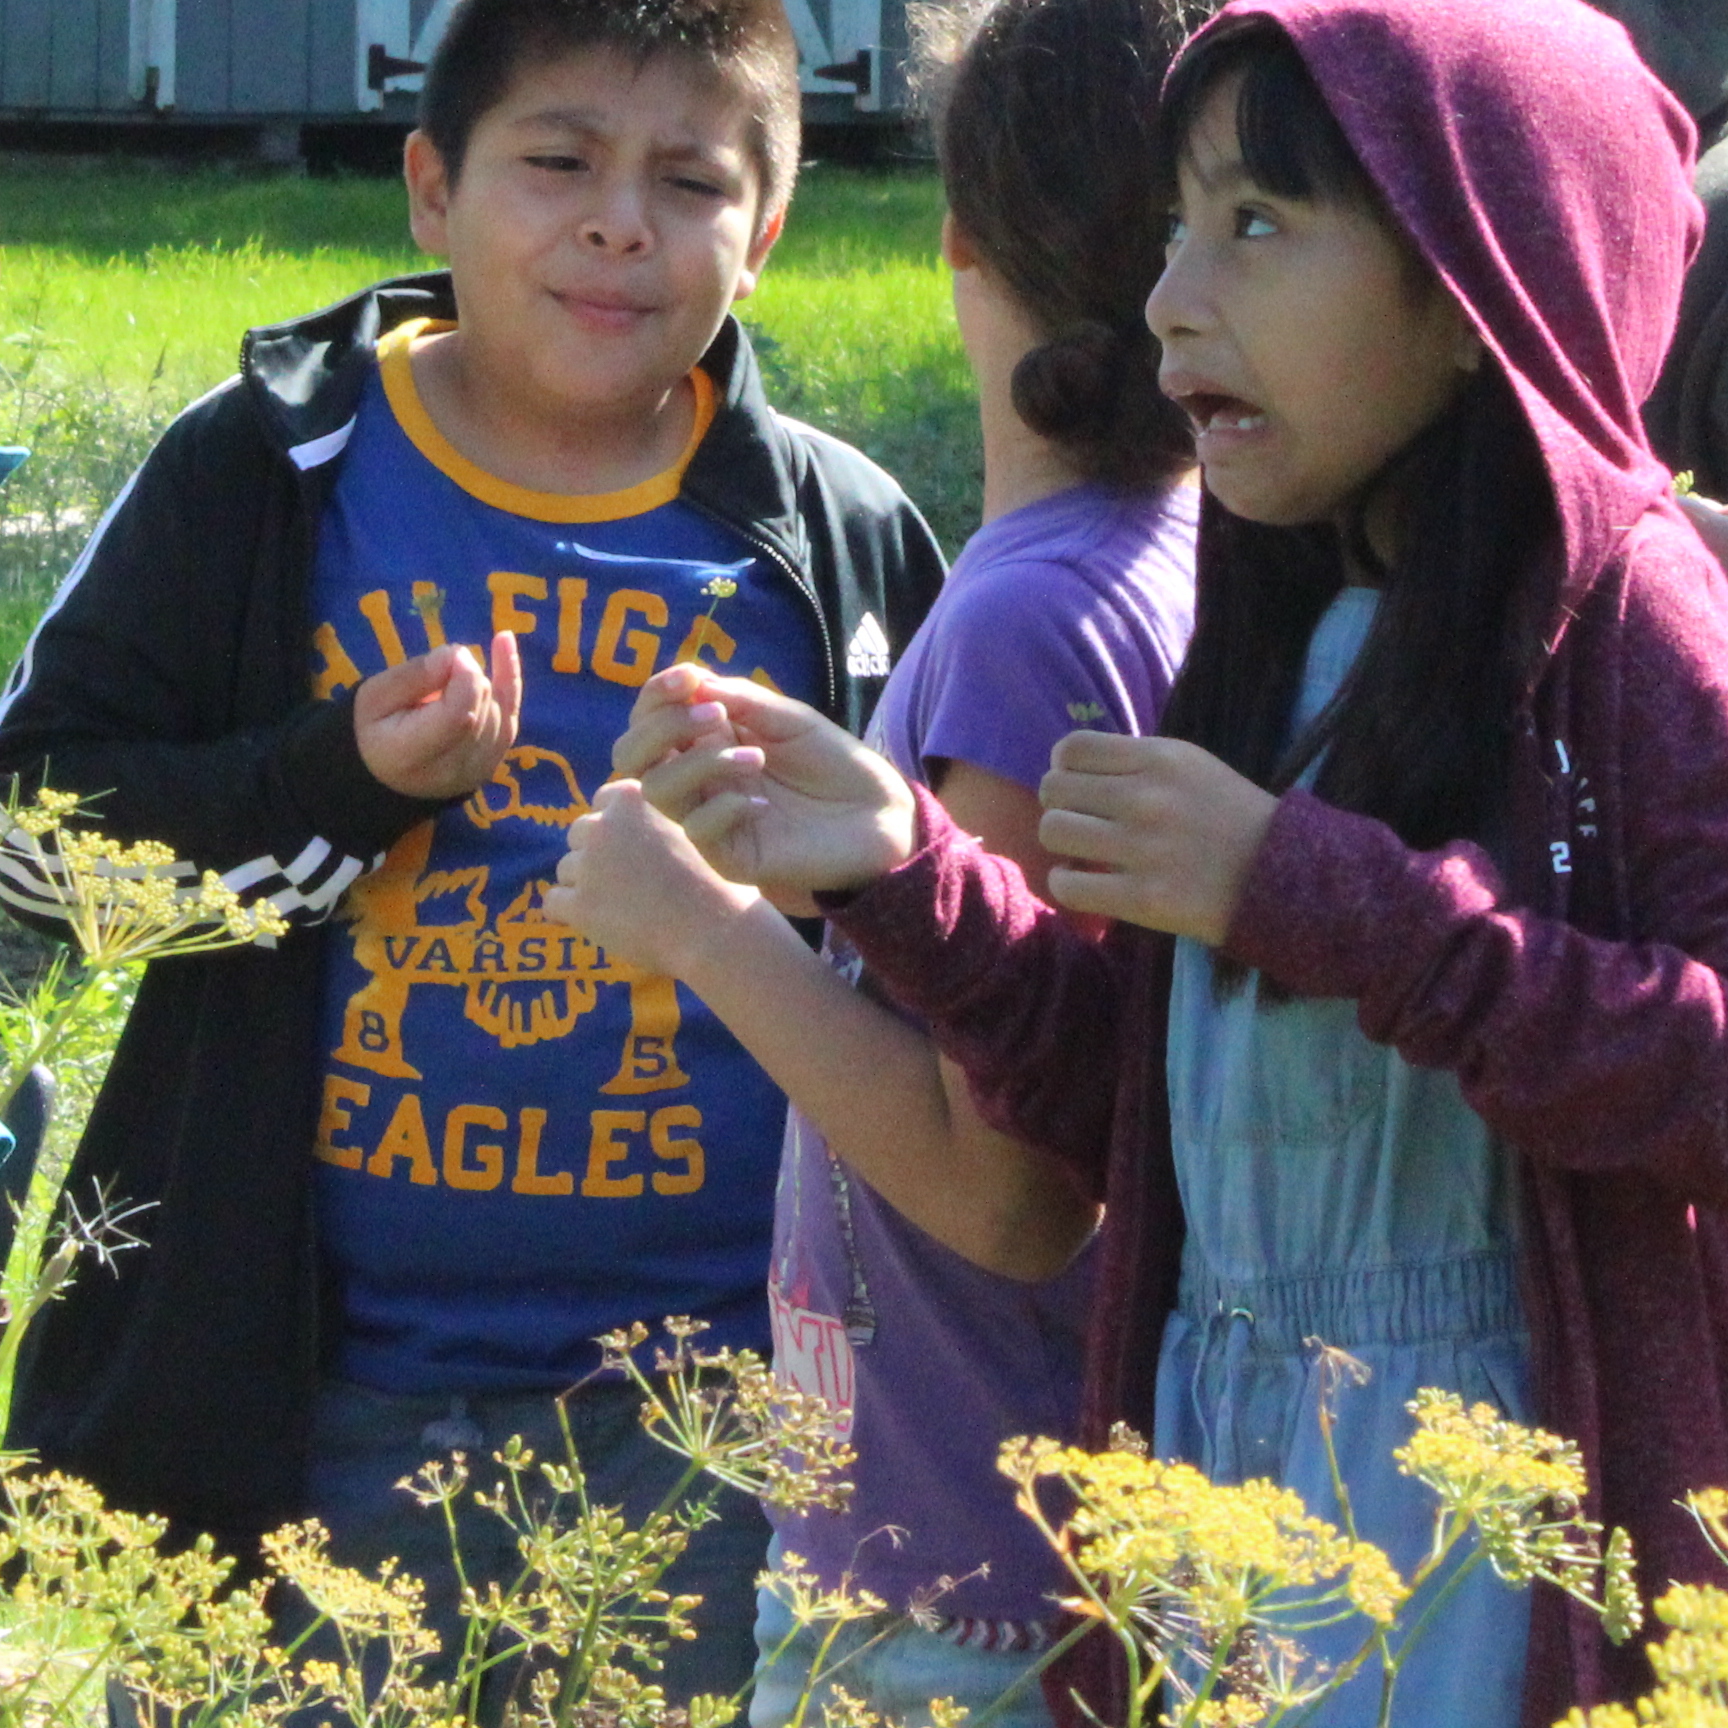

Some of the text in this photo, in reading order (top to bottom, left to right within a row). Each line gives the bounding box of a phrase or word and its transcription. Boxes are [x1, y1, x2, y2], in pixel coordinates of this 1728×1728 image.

[384, 928, 614, 974] VARSIT
[358, 1010, 669, 1079] 8 5
[312, 1073, 706, 1198] EAGLES
